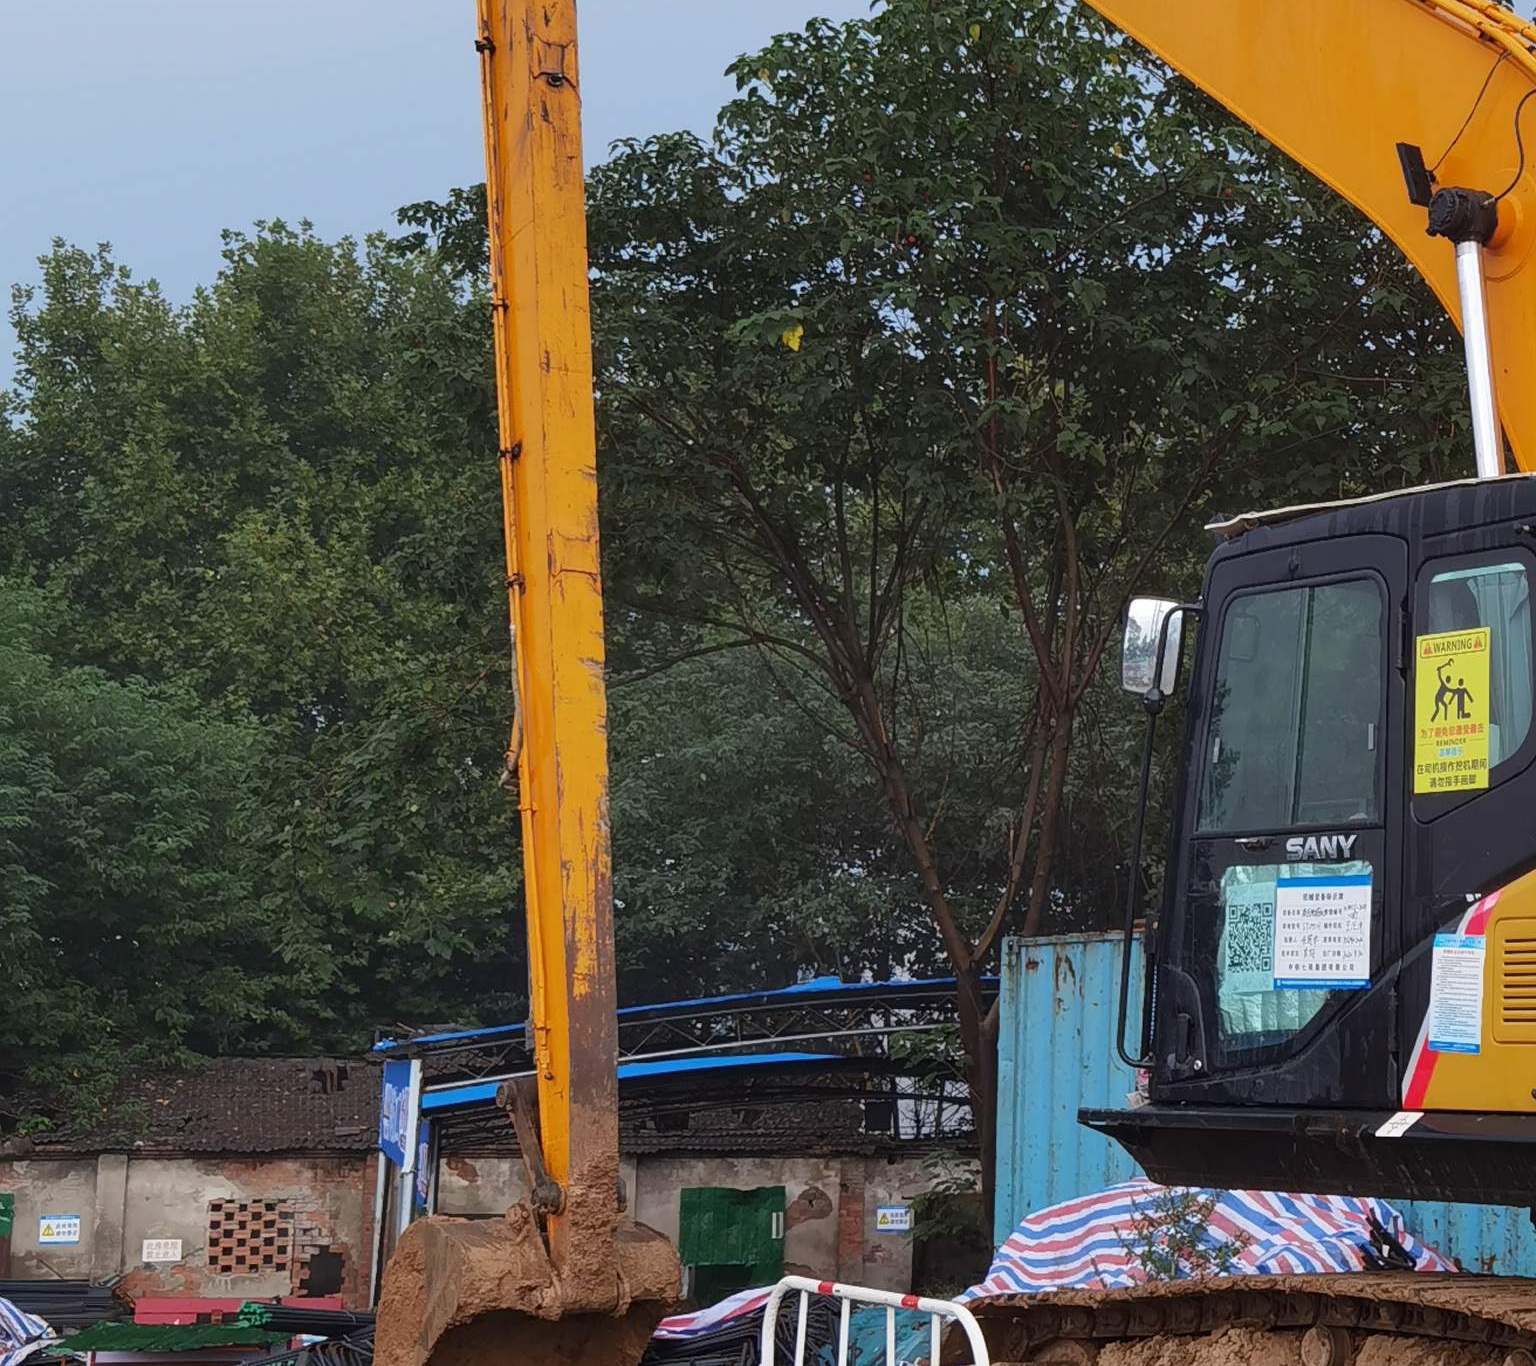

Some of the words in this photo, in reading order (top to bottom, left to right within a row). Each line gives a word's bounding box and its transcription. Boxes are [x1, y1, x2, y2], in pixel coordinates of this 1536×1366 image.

[1433, 638, 1473, 654] WARNING
[1416, 758, 1488, 775] 在司机操作挖机期间
[1285, 834, 1358, 861] SANY
